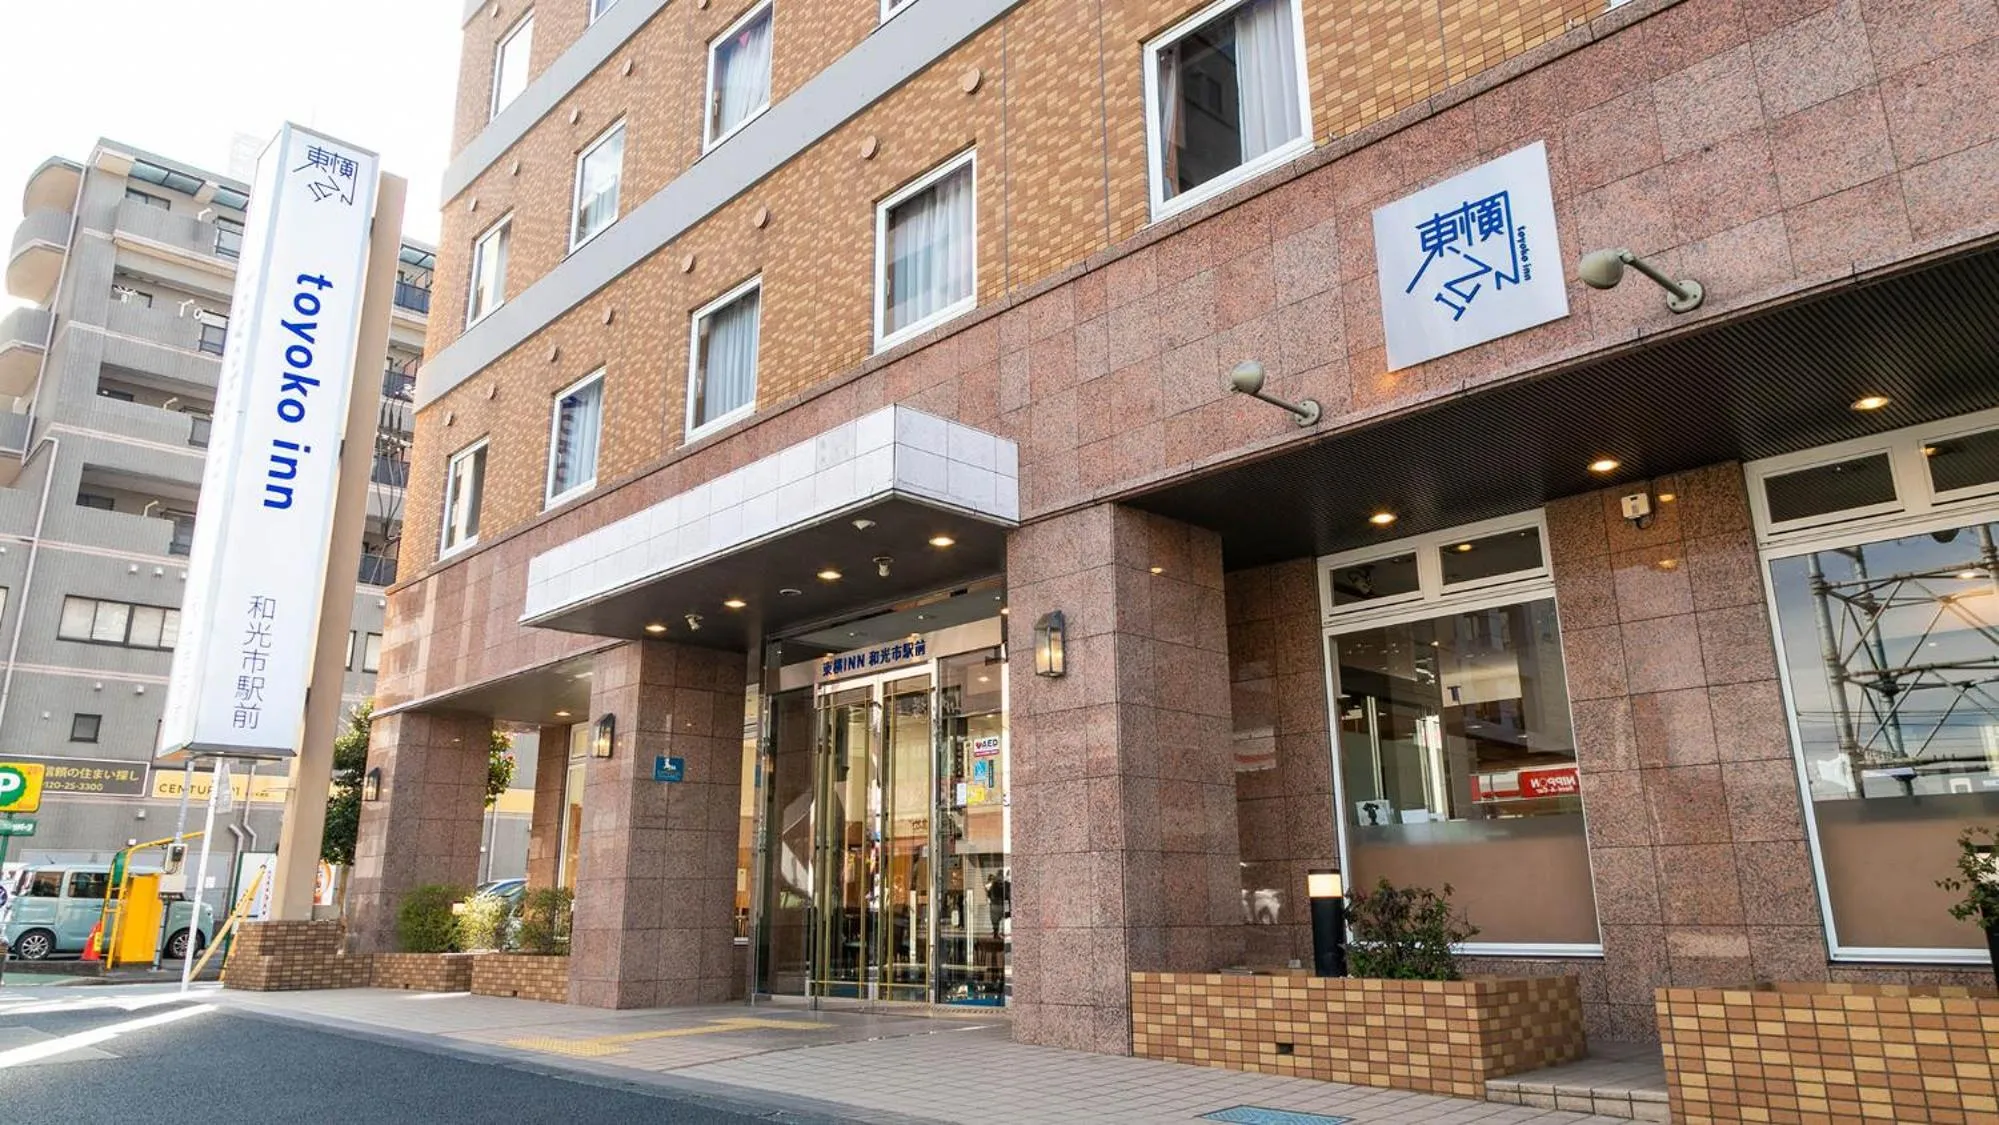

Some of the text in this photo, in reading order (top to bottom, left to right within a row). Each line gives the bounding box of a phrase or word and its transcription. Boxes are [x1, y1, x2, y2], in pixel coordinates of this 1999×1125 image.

[1517, 225, 1532, 281] toyoko inn
[263, 272, 333, 510] toyoko inn
[231, 595, 276, 730] 和光市駅前
[823, 640, 926, 676] 東横INN 和光市駅前
[982, 738, 998, 748] AED
[43, 781, 104, 792] 120-25-3300
